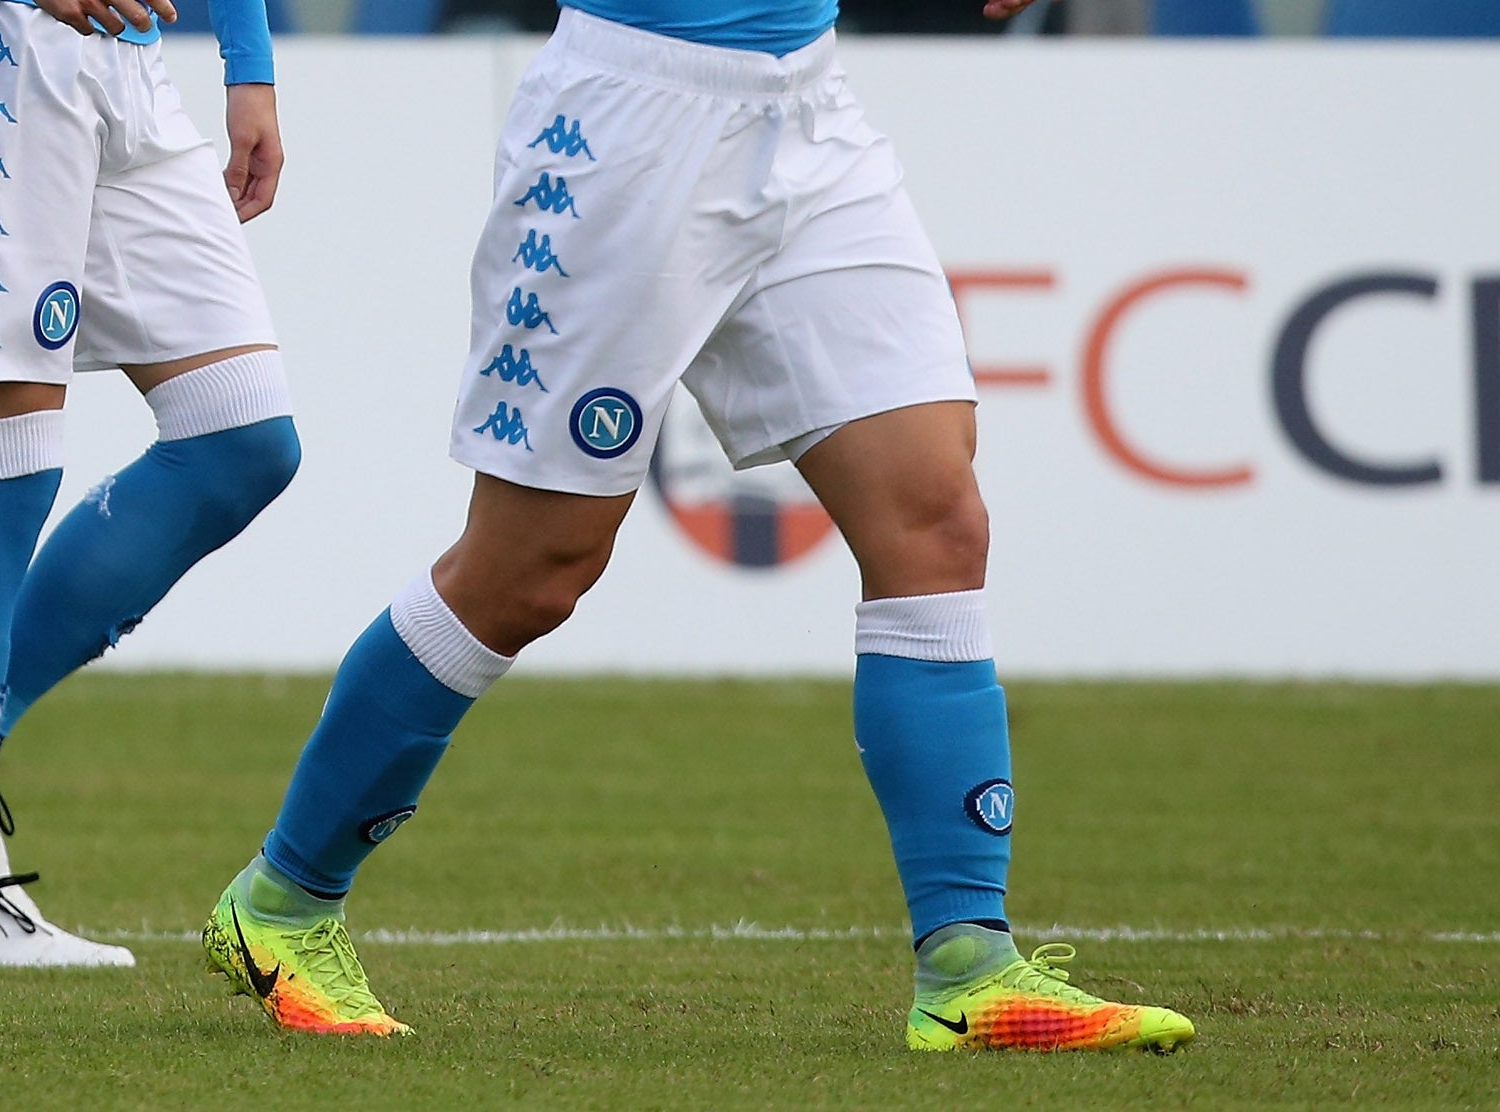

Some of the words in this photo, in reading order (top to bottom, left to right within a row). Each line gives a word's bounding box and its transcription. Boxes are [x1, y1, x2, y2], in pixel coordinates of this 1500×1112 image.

[45, 298, 71, 331] N
[588, 405, 626, 440] N
[988, 791, 1010, 819] N
